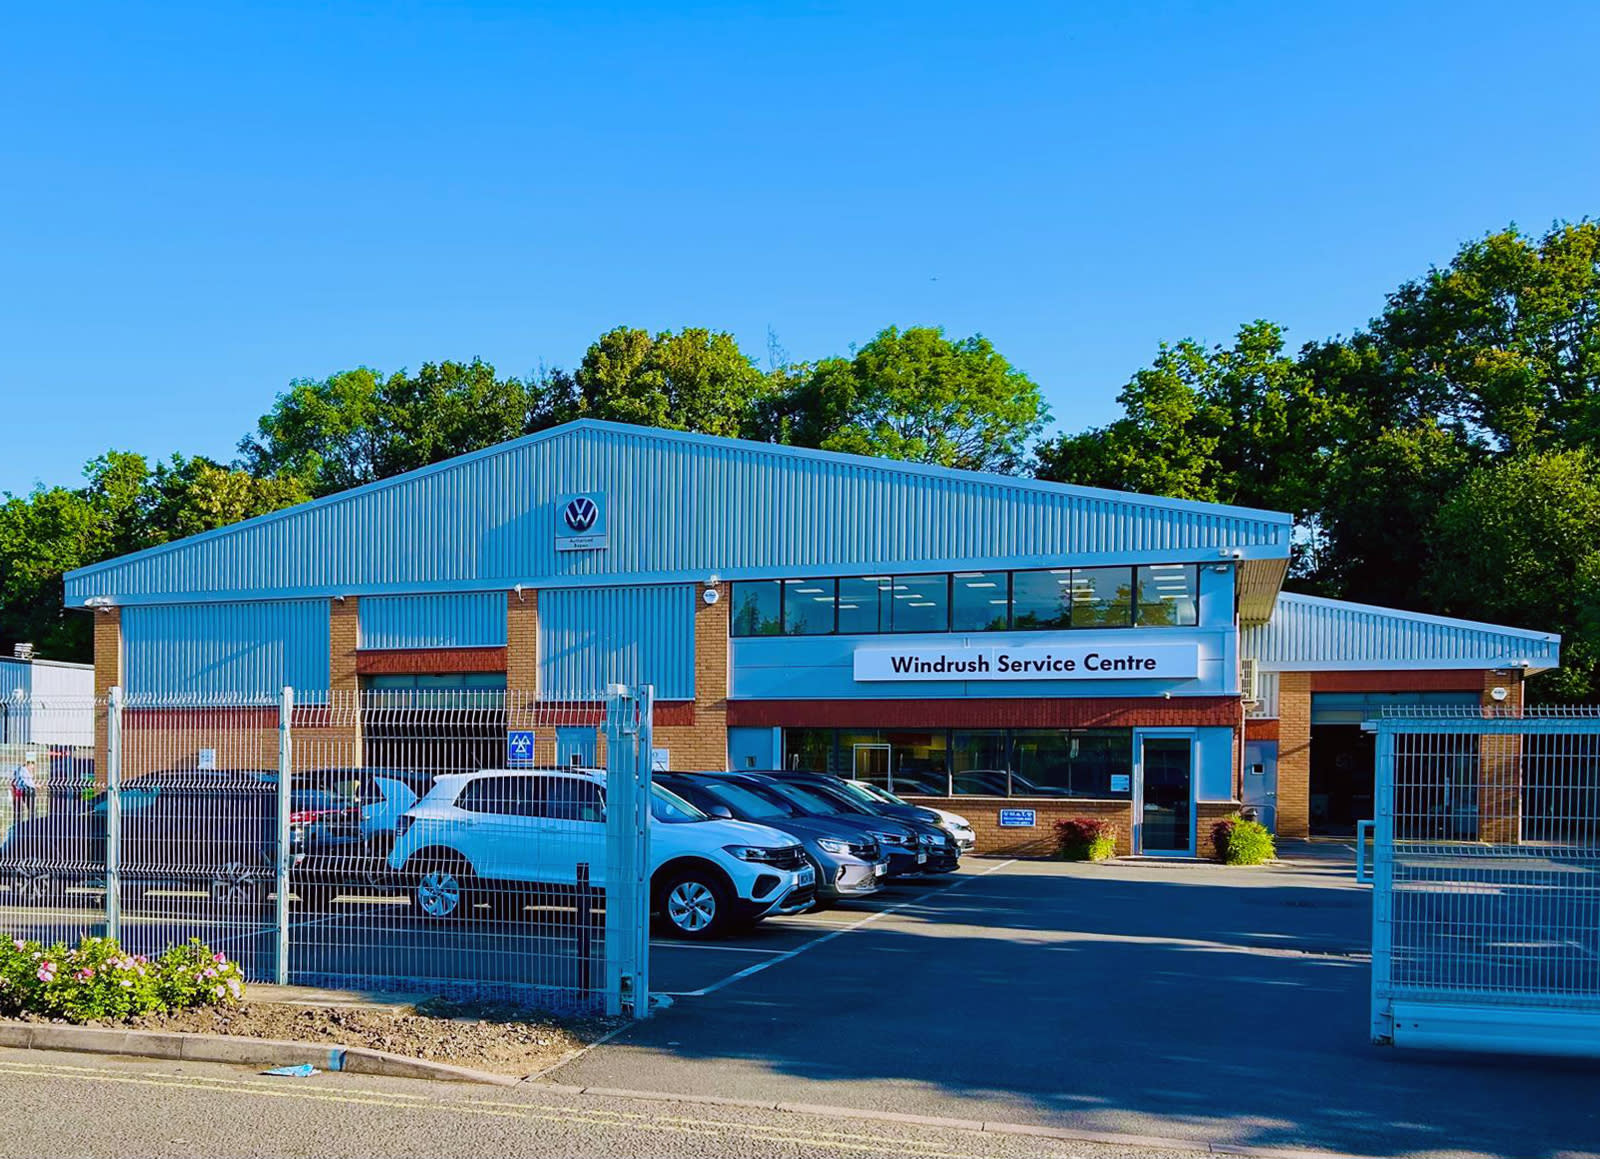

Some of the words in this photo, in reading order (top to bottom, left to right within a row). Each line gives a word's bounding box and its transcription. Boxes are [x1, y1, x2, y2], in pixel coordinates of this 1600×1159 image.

[890, 655, 990, 673] Windrush
[996, 654, 1076, 673] Service
[1083, 653, 1157, 672] Centre
